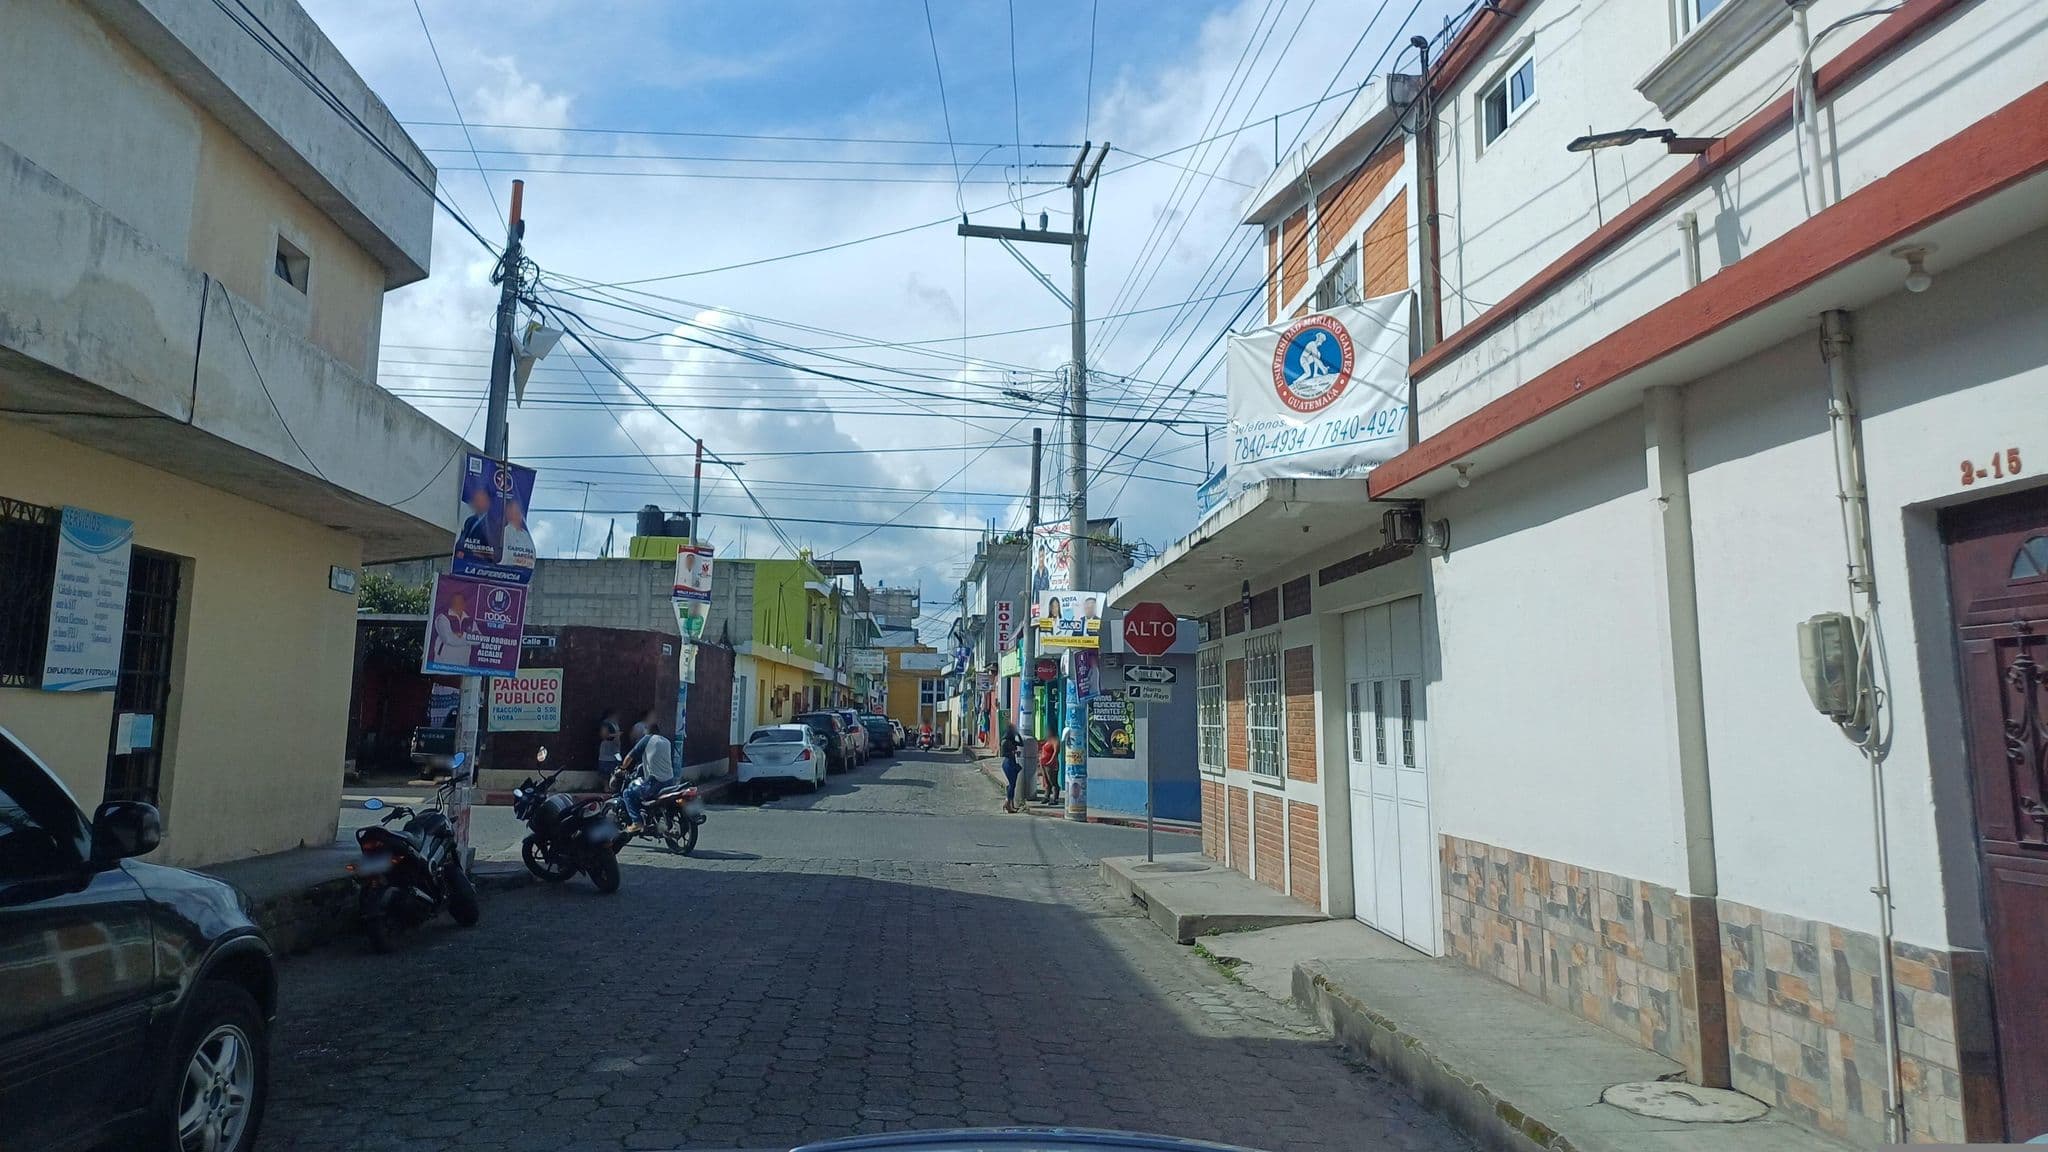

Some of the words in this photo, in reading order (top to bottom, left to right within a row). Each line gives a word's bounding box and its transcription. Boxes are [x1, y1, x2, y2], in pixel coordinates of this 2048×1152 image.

[1273, 321, 1302, 388] UNIVERSIDAD
[1302, 315, 1342, 335] MARIANO
[1339, 333, 1353, 374] GALVEZ
[1287, 388, 1339, 410] GUATEMALA
[1233, 426, 1307, 462] 7840-4934
[1321, 405, 1409, 444] 7840-4927
[1960, 447, 2022, 486] 2-15
[464, 566, 476, 574] LA
[484, 611, 512, 623] TODOS
[998, 602, 1010, 651] HOTEL
[1125, 621, 1176, 638] ALTO
[493, 678, 559, 691] PARQUEO
[495, 692, 556, 705] PUBLICO
